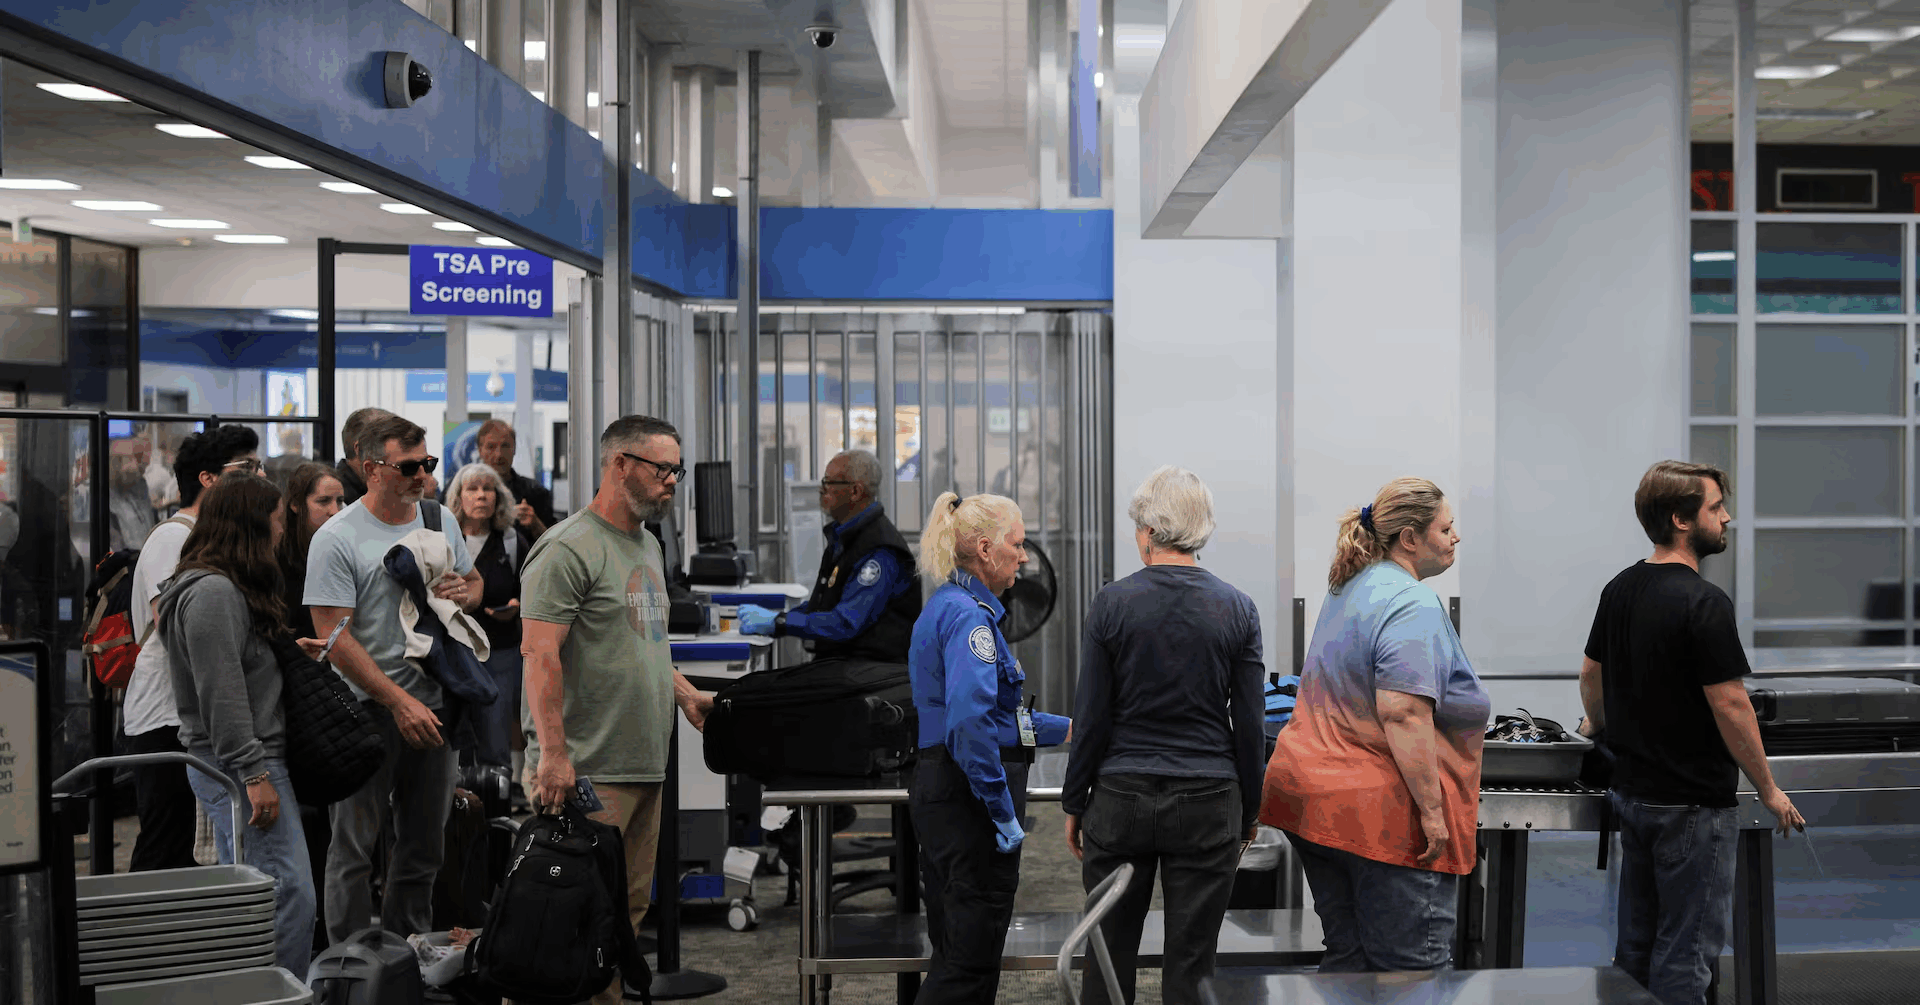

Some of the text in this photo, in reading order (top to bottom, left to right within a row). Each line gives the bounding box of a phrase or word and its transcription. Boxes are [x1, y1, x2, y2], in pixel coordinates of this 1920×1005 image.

[433, 252, 530, 276] TSA Pre
[421, 281, 543, 310] Screening
